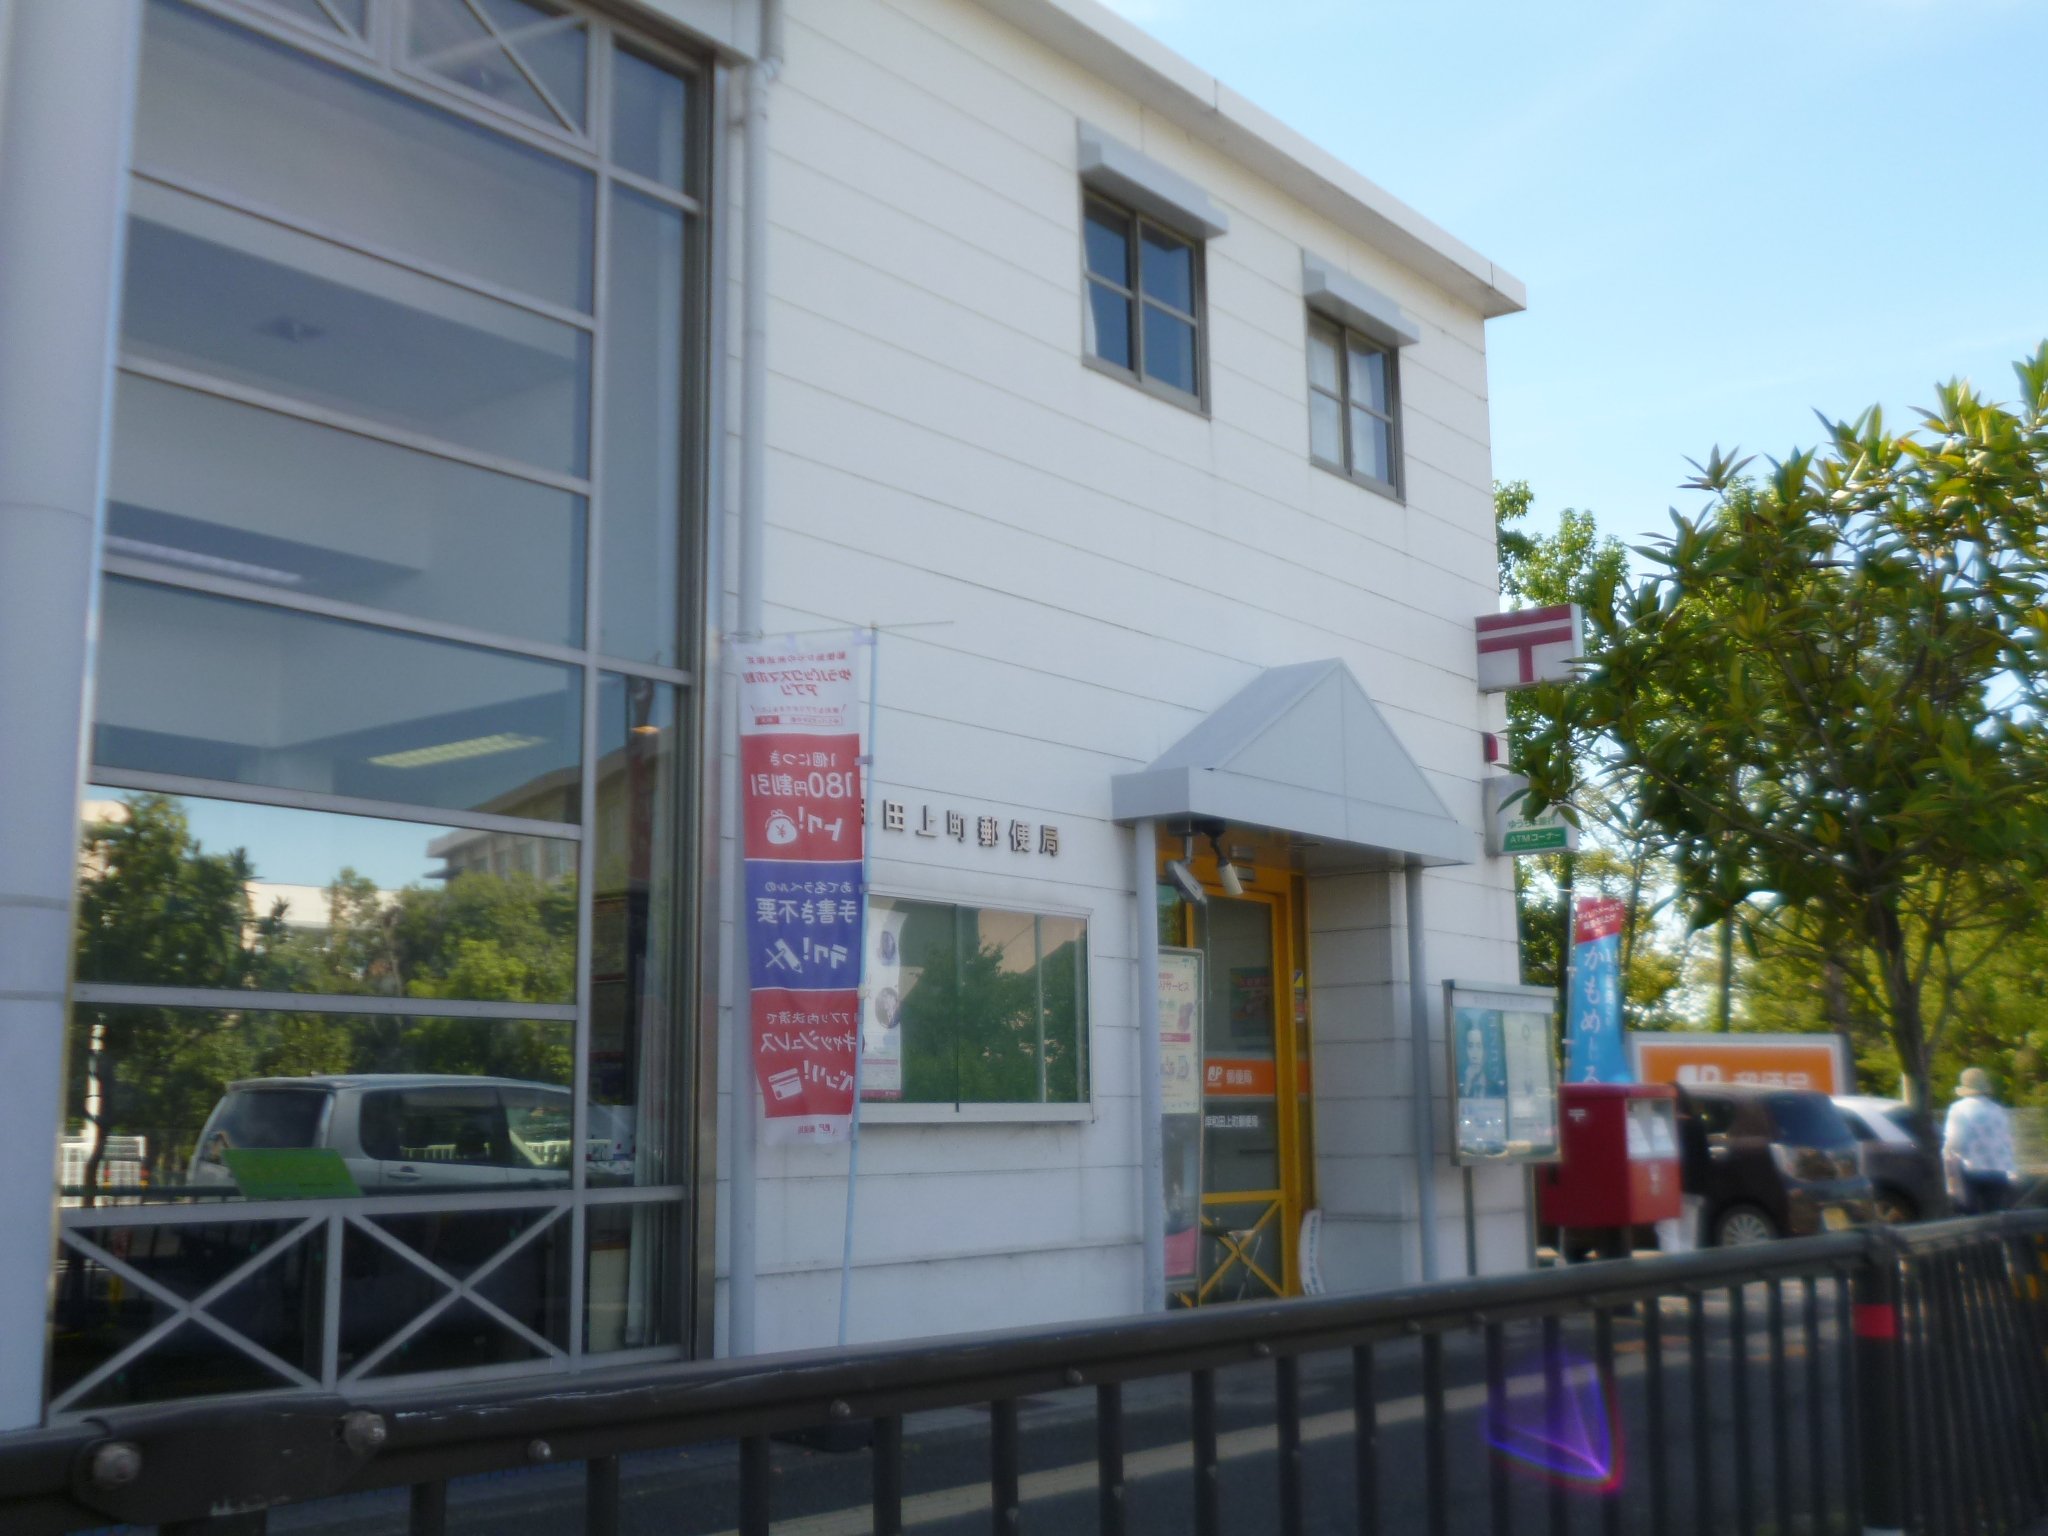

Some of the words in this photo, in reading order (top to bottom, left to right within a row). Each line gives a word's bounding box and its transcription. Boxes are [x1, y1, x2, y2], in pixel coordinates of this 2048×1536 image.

[861, 798, 1060, 857] 田上町郵便局
